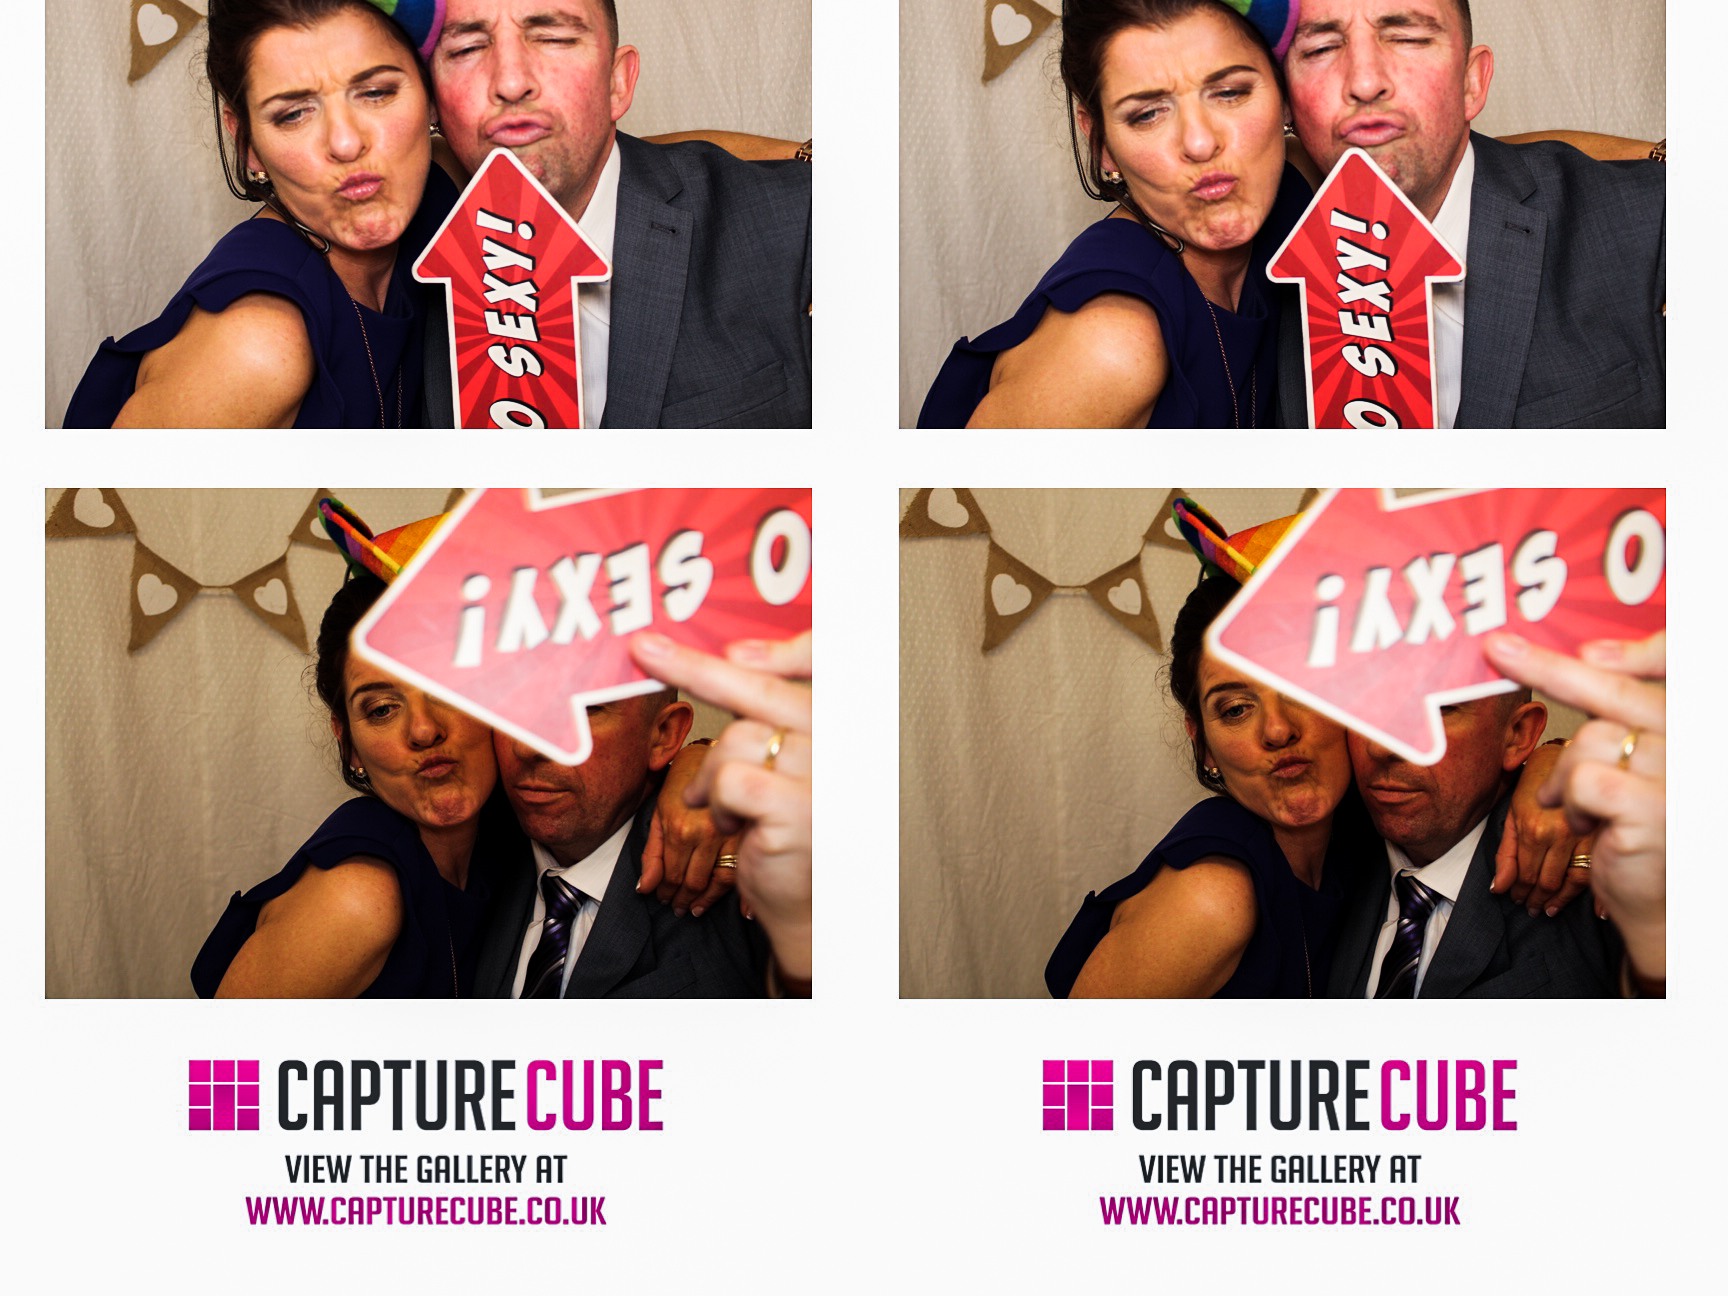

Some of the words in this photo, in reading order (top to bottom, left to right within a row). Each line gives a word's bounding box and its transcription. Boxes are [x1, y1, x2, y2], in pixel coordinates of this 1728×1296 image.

[475, 207, 544, 378] SEXY!
[1329, 207, 1398, 378] SEXY!
[452, 528, 714, 668] SEXY!
[1306, 528, 1568, 668] SEXY!
